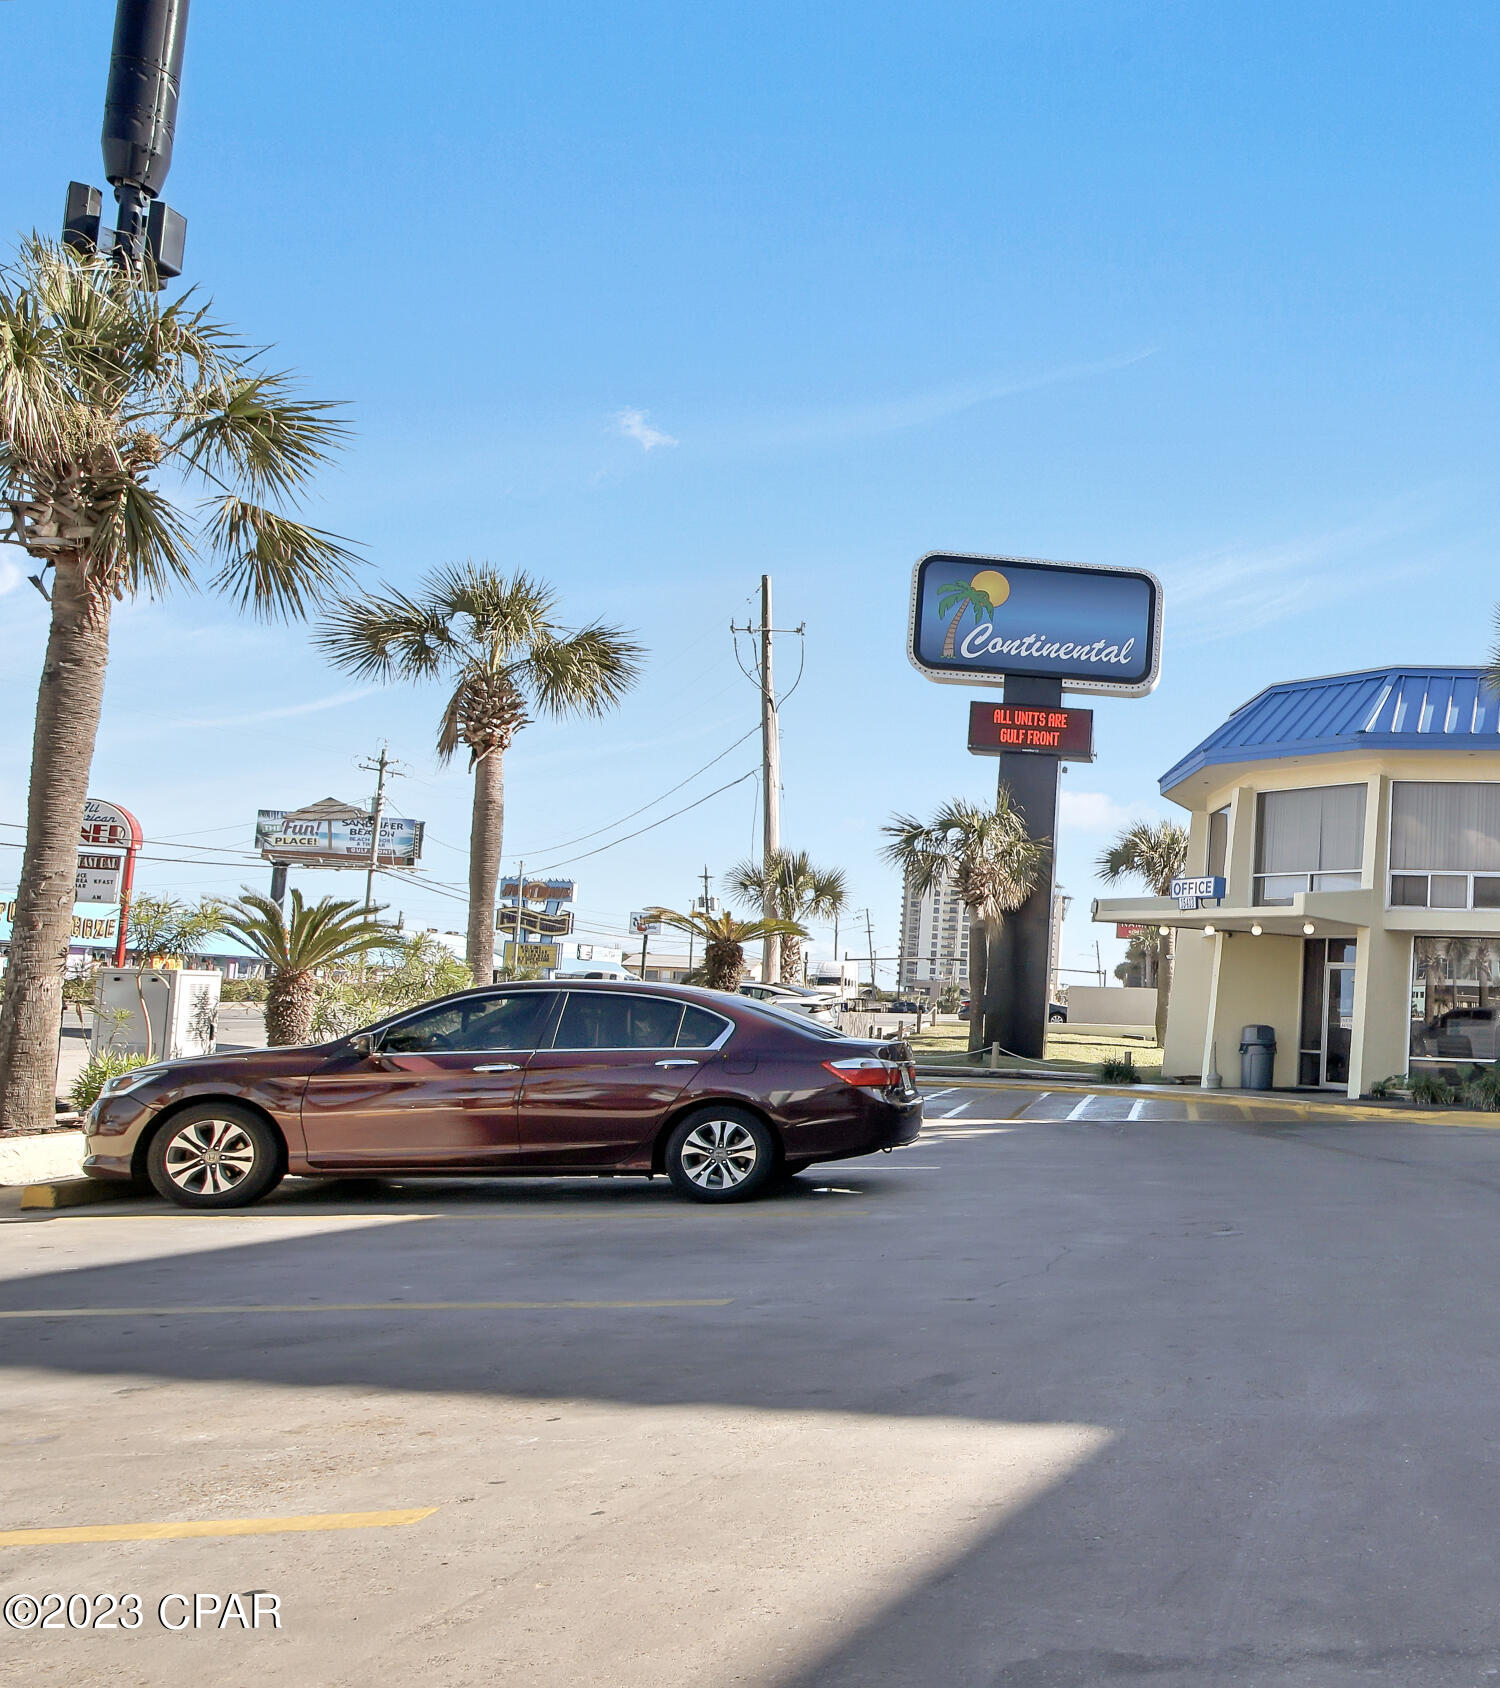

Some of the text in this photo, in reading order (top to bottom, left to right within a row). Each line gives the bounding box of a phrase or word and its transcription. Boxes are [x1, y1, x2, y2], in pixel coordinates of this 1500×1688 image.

[960, 623, 1135, 664] Continental
[994, 709, 1068, 728] ALL UNITS ARE
[1000, 728, 1060, 746] GULF FRONT
[342, 819, 404, 830] SANDIPER
[349, 828, 395, 838] BEAON
[275, 837, 317, 846] PLACE!
[1174, 881, 1212, 896] OFFICE
